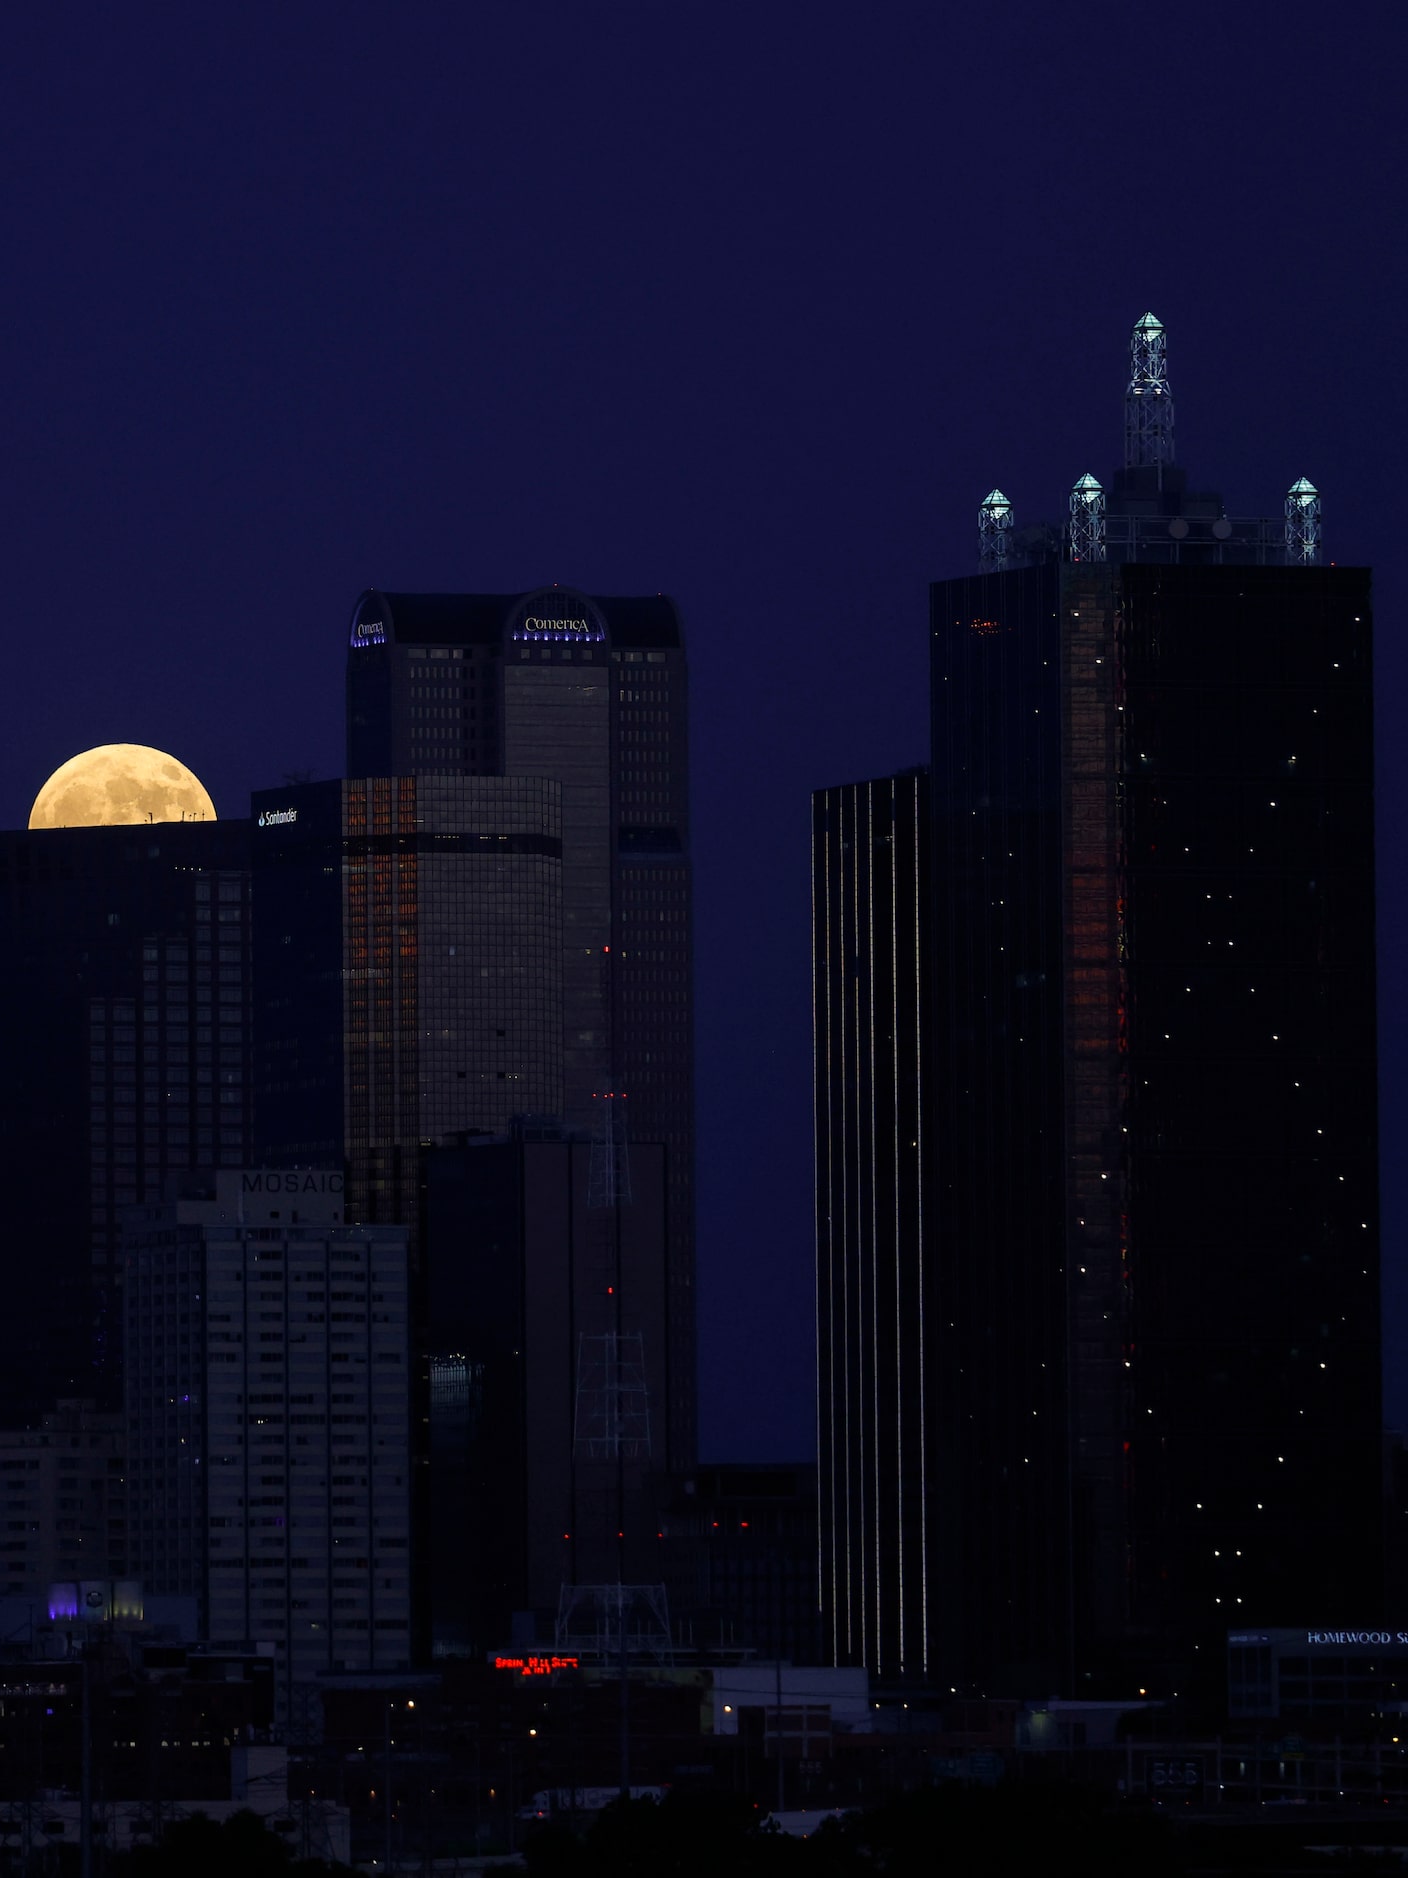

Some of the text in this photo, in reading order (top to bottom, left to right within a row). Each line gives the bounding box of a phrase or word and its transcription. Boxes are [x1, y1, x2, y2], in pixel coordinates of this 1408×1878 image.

[266, 808, 297, 825] Santander
[242, 1174, 344, 1192] MOSAIC
[1307, 1631, 1391, 1644] HOMEWOOD
